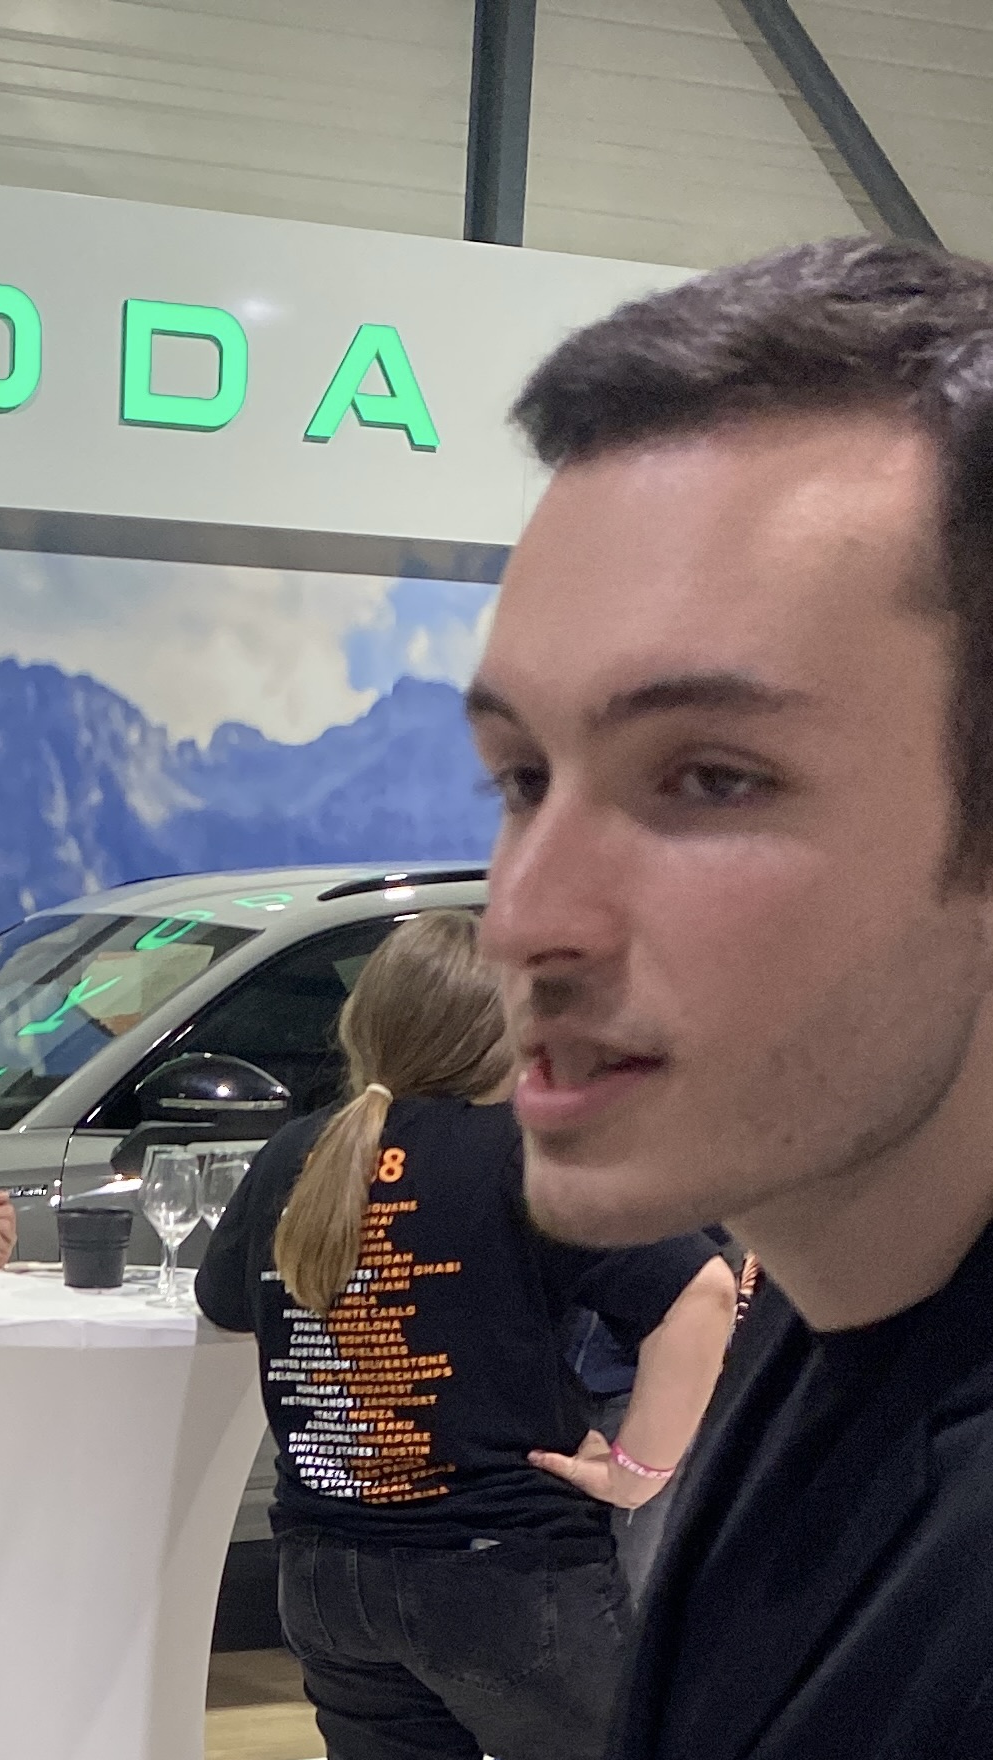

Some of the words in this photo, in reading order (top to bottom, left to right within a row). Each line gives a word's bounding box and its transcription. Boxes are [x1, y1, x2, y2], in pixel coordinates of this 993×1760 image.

[289, 1333, 332, 1345] CANADA
[348, 1408, 396, 1420] MONZA
[376, 1419, 415, 1431] BAKU
[299, 1467, 348, 1479] BRAZIL
